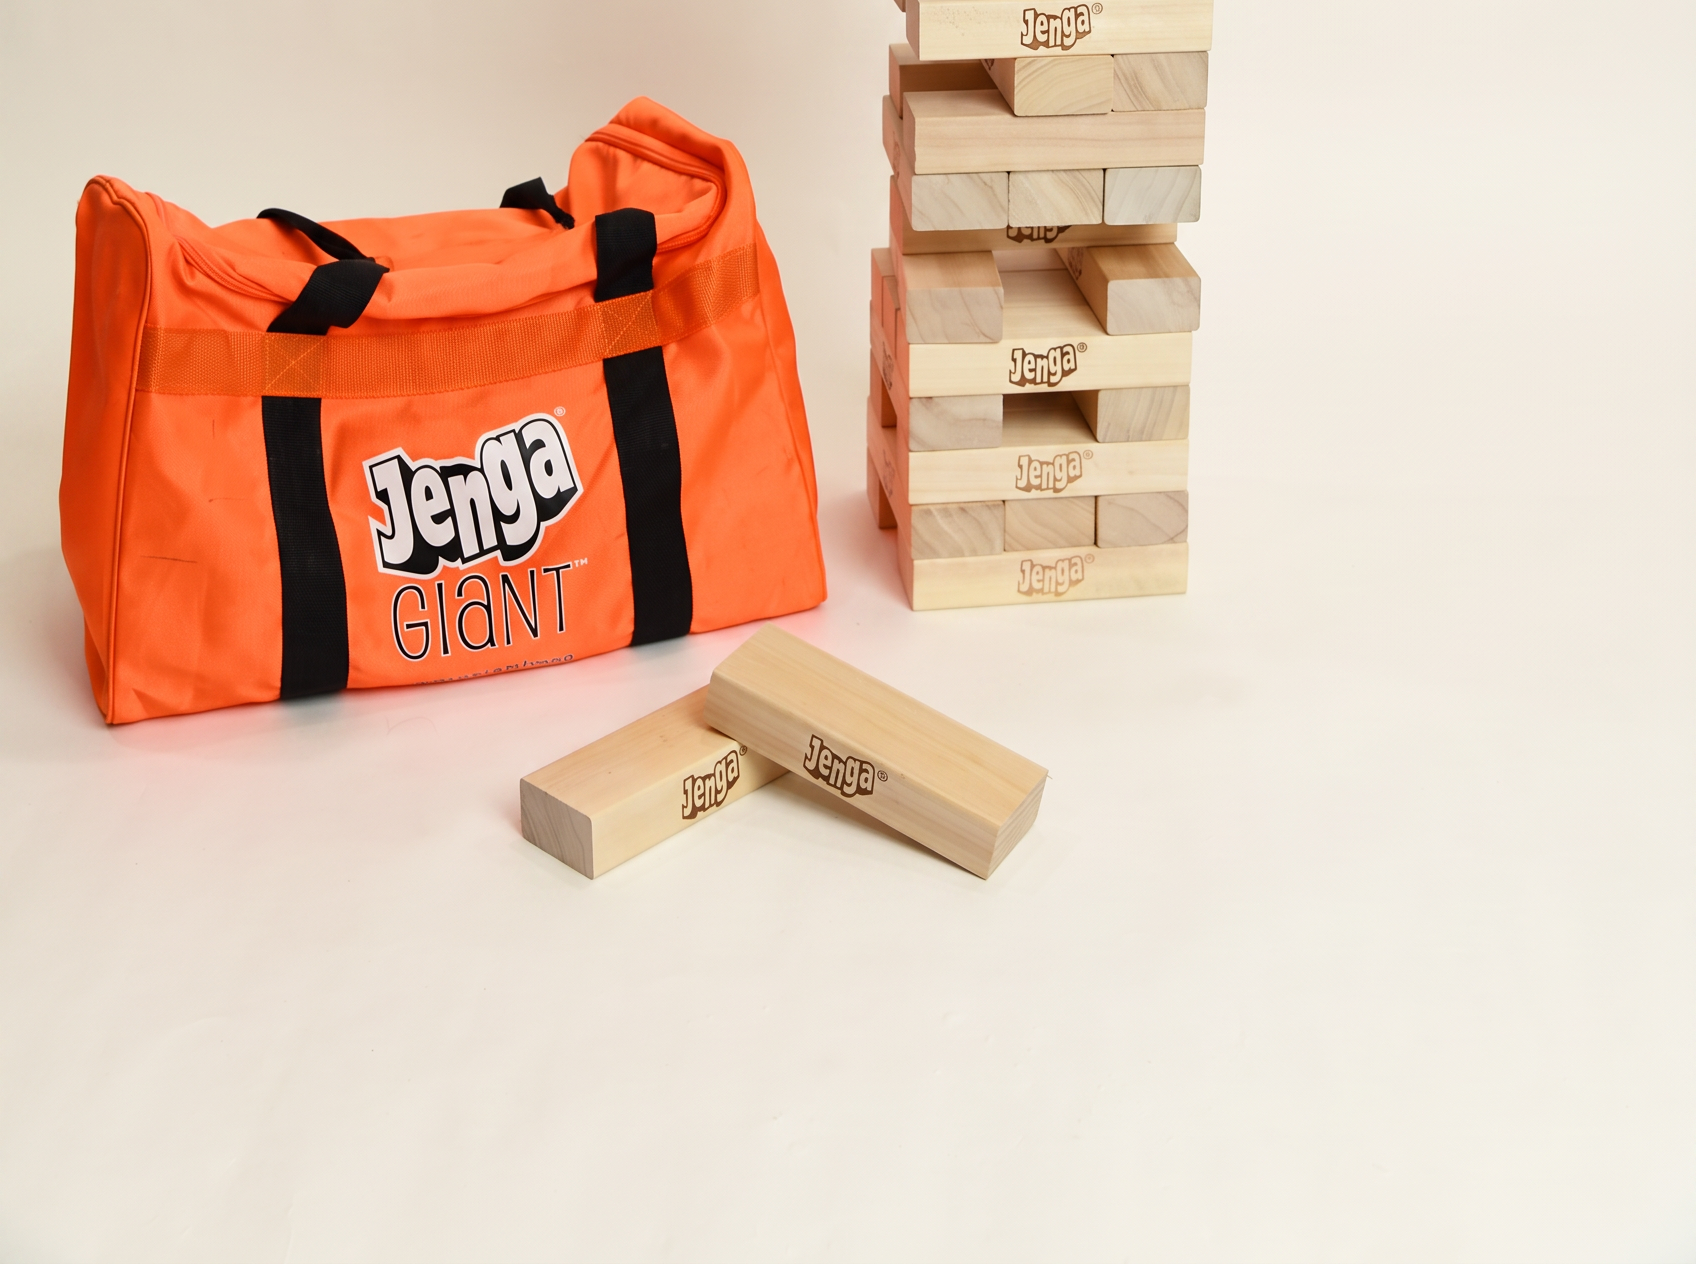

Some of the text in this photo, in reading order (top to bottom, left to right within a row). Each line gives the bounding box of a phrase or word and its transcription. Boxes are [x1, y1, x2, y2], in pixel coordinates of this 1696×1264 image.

[1020, 2, 1092, 51] Jenga
[1009, 343, 1077, 387] Jenga
[1015, 450, 1083, 493] Jenga
[362, 413, 584, 580] Jenga
[1017, 554, 1085, 596] Jenga
[681, 749, 741, 820] Jenga
[803, 734, 876, 798] Jenga
